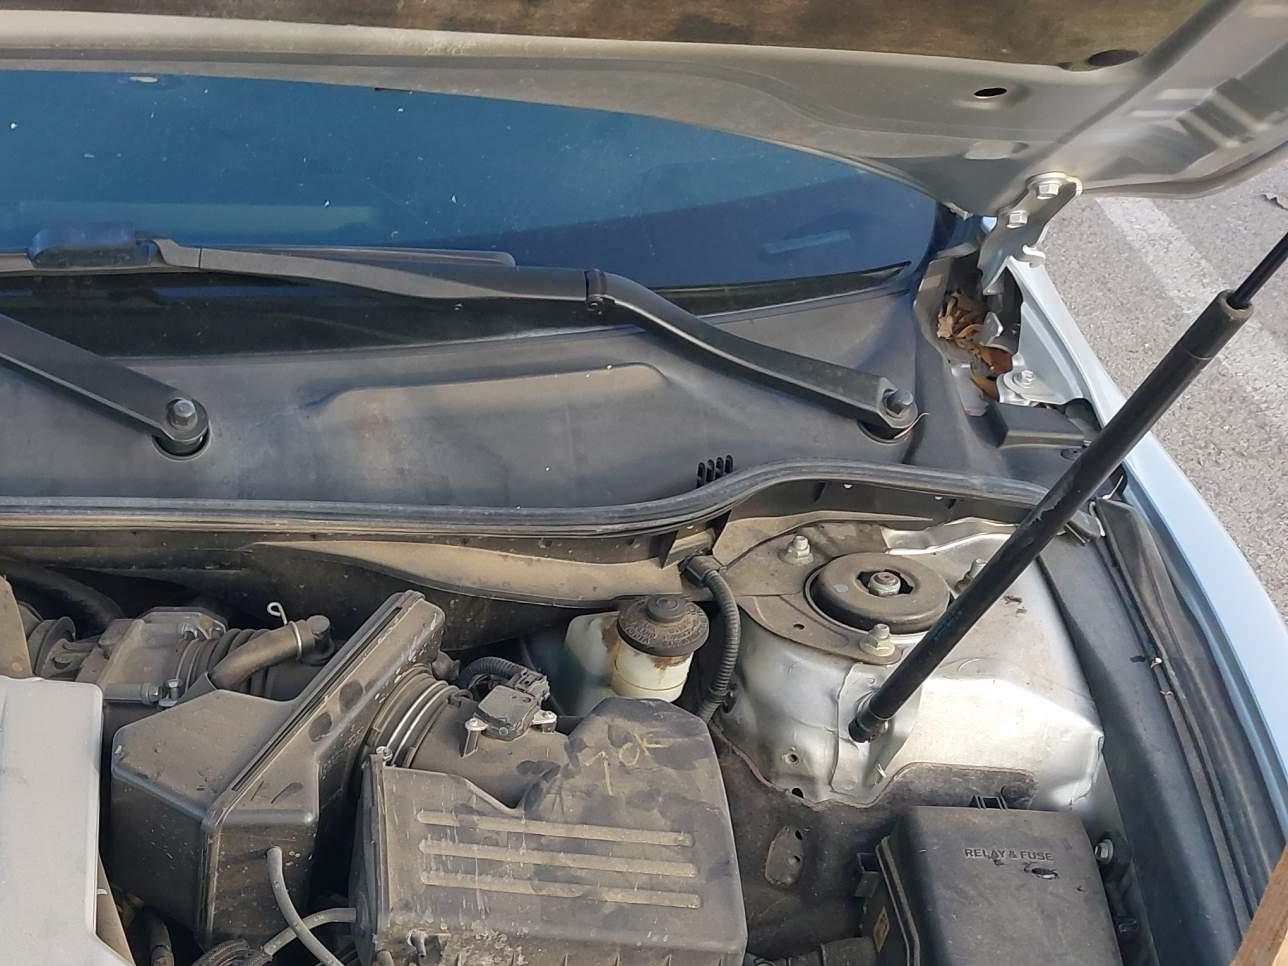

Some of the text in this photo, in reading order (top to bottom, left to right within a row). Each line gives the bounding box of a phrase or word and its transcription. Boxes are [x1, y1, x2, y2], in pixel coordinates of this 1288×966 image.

[964, 848, 1055, 861] RELAY & FUSE
